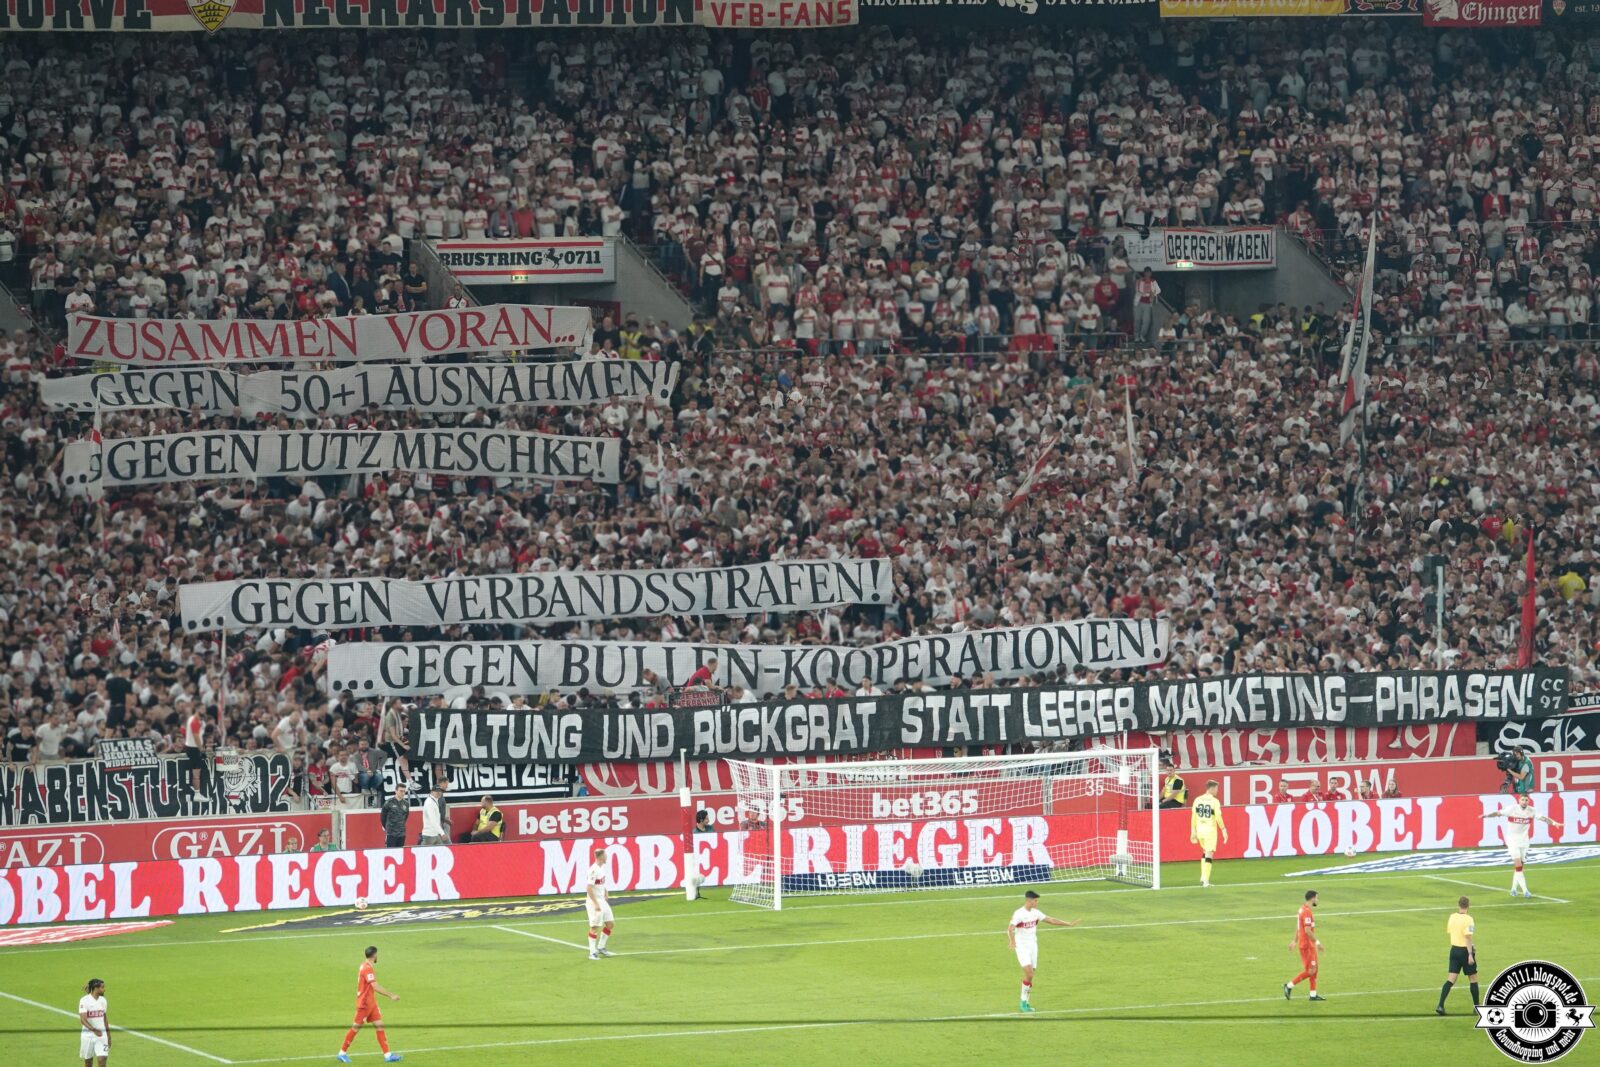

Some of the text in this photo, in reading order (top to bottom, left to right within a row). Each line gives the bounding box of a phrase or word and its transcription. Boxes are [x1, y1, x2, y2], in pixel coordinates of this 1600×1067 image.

[710, 0, 852, 27] VFB-FANS
[1461, 2, 1541, 25] Ehingen
[439, 248, 601, 267] BRUSTRING 0711
[1167, 233, 1270, 262] OBERSCHWABEN
[75, 306, 576, 361] ZUSAMMEN VORAN...
[281, 371, 370, 416] 50+1
[383, 359, 676, 407] AUSNAHMEN!
[278, 431, 382, 473] LUTZ
[392, 431, 606, 479] MESCHKE!
[424, 559, 882, 622] VERBANDSSTRAFEN!
[1540, 695, 1562, 710] 97
[417, 712, 583, 760] HALTUNG
[602, 711, 675, 760] UND
[693, 701, 877, 756] RÜCKGRAT
[901, 691, 1012, 745] STATT
[1022, 685, 1139, 738] LEERER
[101, 740, 153, 753] ULTRAS
[103, 750, 155, 761] BEDEUTET
[105, 757, 159, 768] WIDERSTAND
[1087, 779, 1103, 796] 35
[872, 789, 979, 818] bet365
[1198, 804, 1211, 818] 33
[519, 806, 629, 835] bet365
[1244, 796, 1454, 859] MÖBEL
[538, 816, 1055, 896] MÖBEL RIEGER
[177, 844, 461, 915] RIEGER
